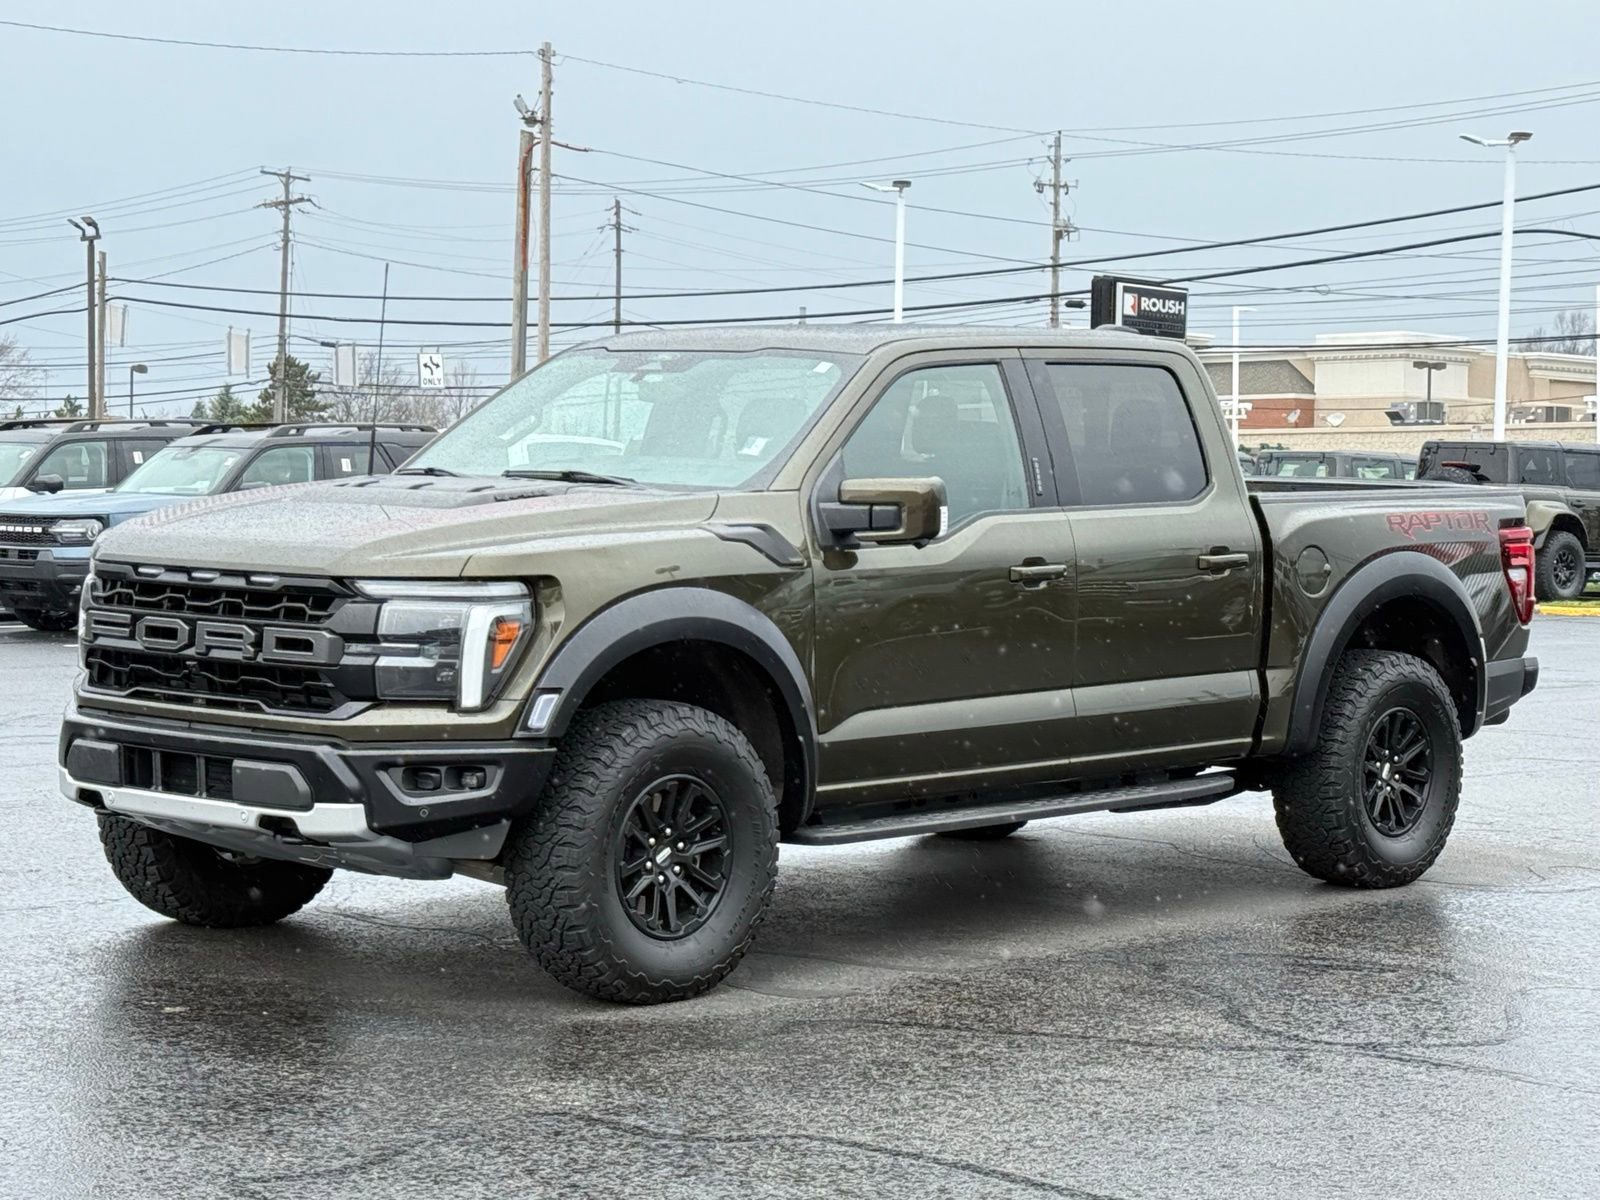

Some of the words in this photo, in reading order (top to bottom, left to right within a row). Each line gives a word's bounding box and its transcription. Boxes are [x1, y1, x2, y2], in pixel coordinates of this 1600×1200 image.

[1140, 296, 1185, 315] ROUSH
[422, 377, 441, 386] ONLY
[1385, 512, 1498, 541] RAPTOR
[83, 610, 345, 669] FORD
